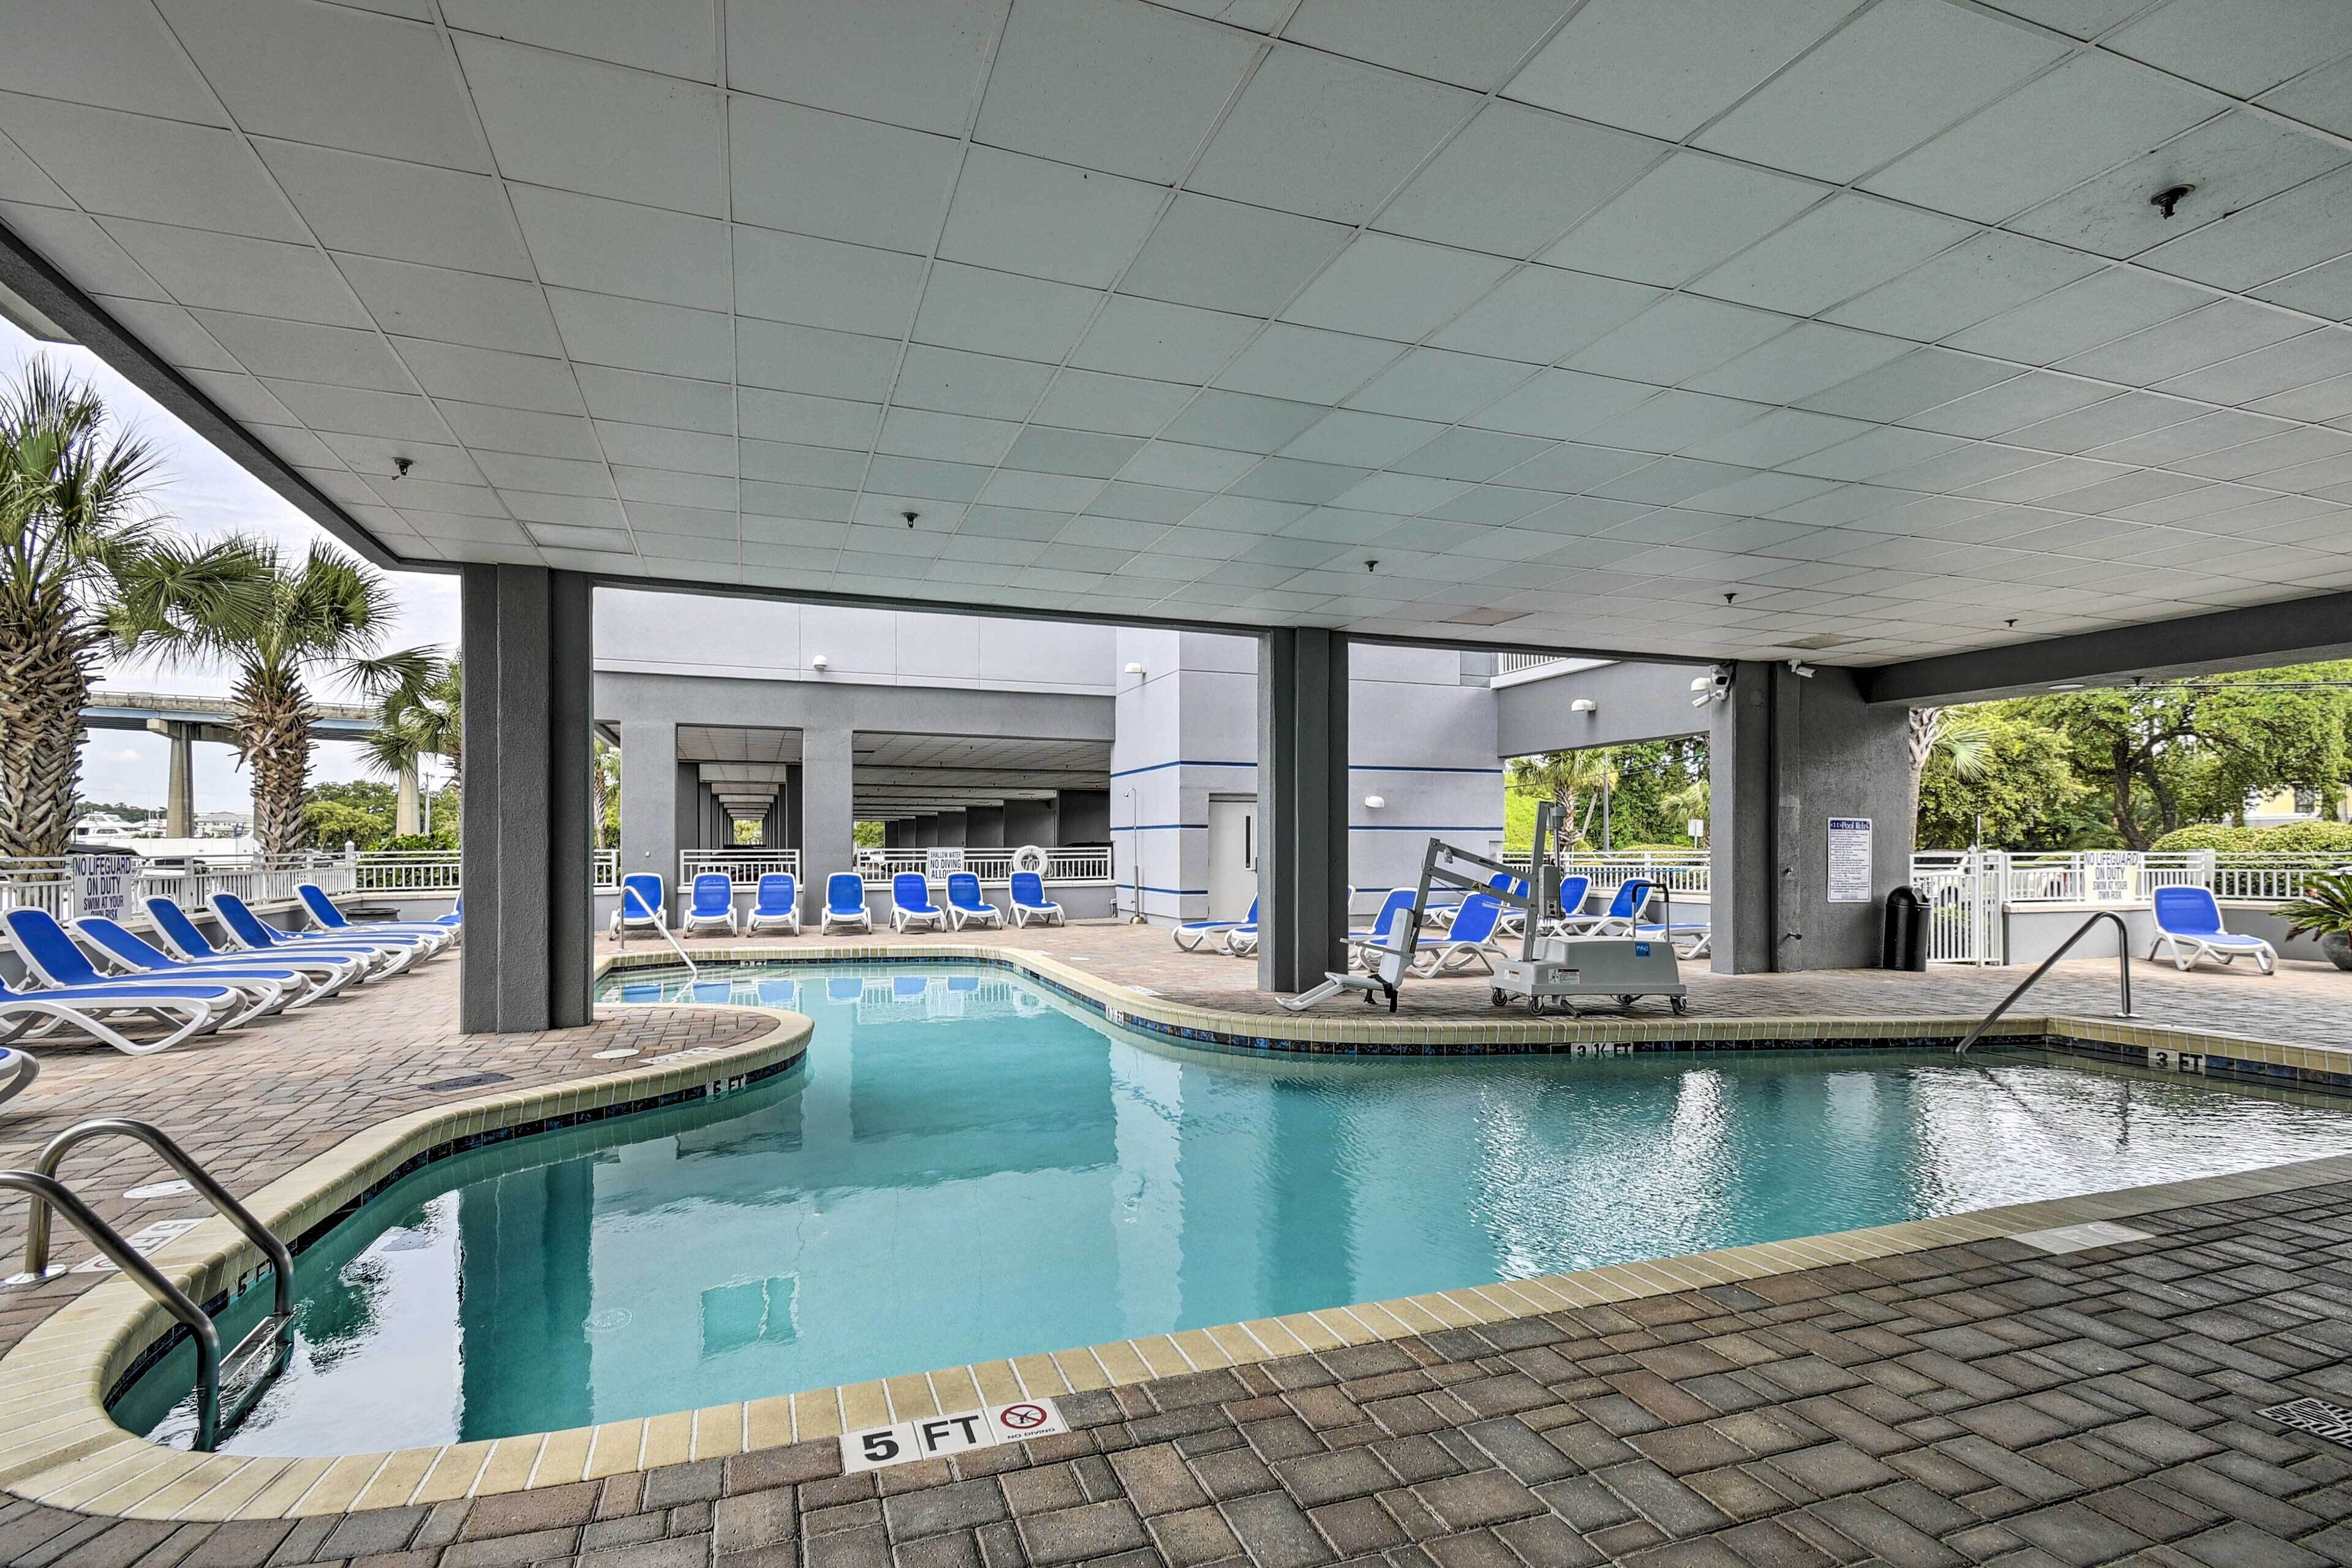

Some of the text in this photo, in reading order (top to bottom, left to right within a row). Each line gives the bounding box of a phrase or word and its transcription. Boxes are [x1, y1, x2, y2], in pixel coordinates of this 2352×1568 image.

[930, 859, 961, 869] NO DIVING
[2086, 852, 2138, 865] NO LIFEGUARD
[74, 856, 131, 876] NO LIFEGUARD
[931, 870, 960, 879] ALLO
[2095, 867, 2125, 880] ON DUTY
[87, 876, 121, 895] ON DUTY
[2093, 881, 2107, 891] SWIM
[83, 895, 124, 911] SWIM AT YOUR
[861, 1414, 979, 1462] 5 FT
[1024, 1427, 1055, 1436] DIVING
